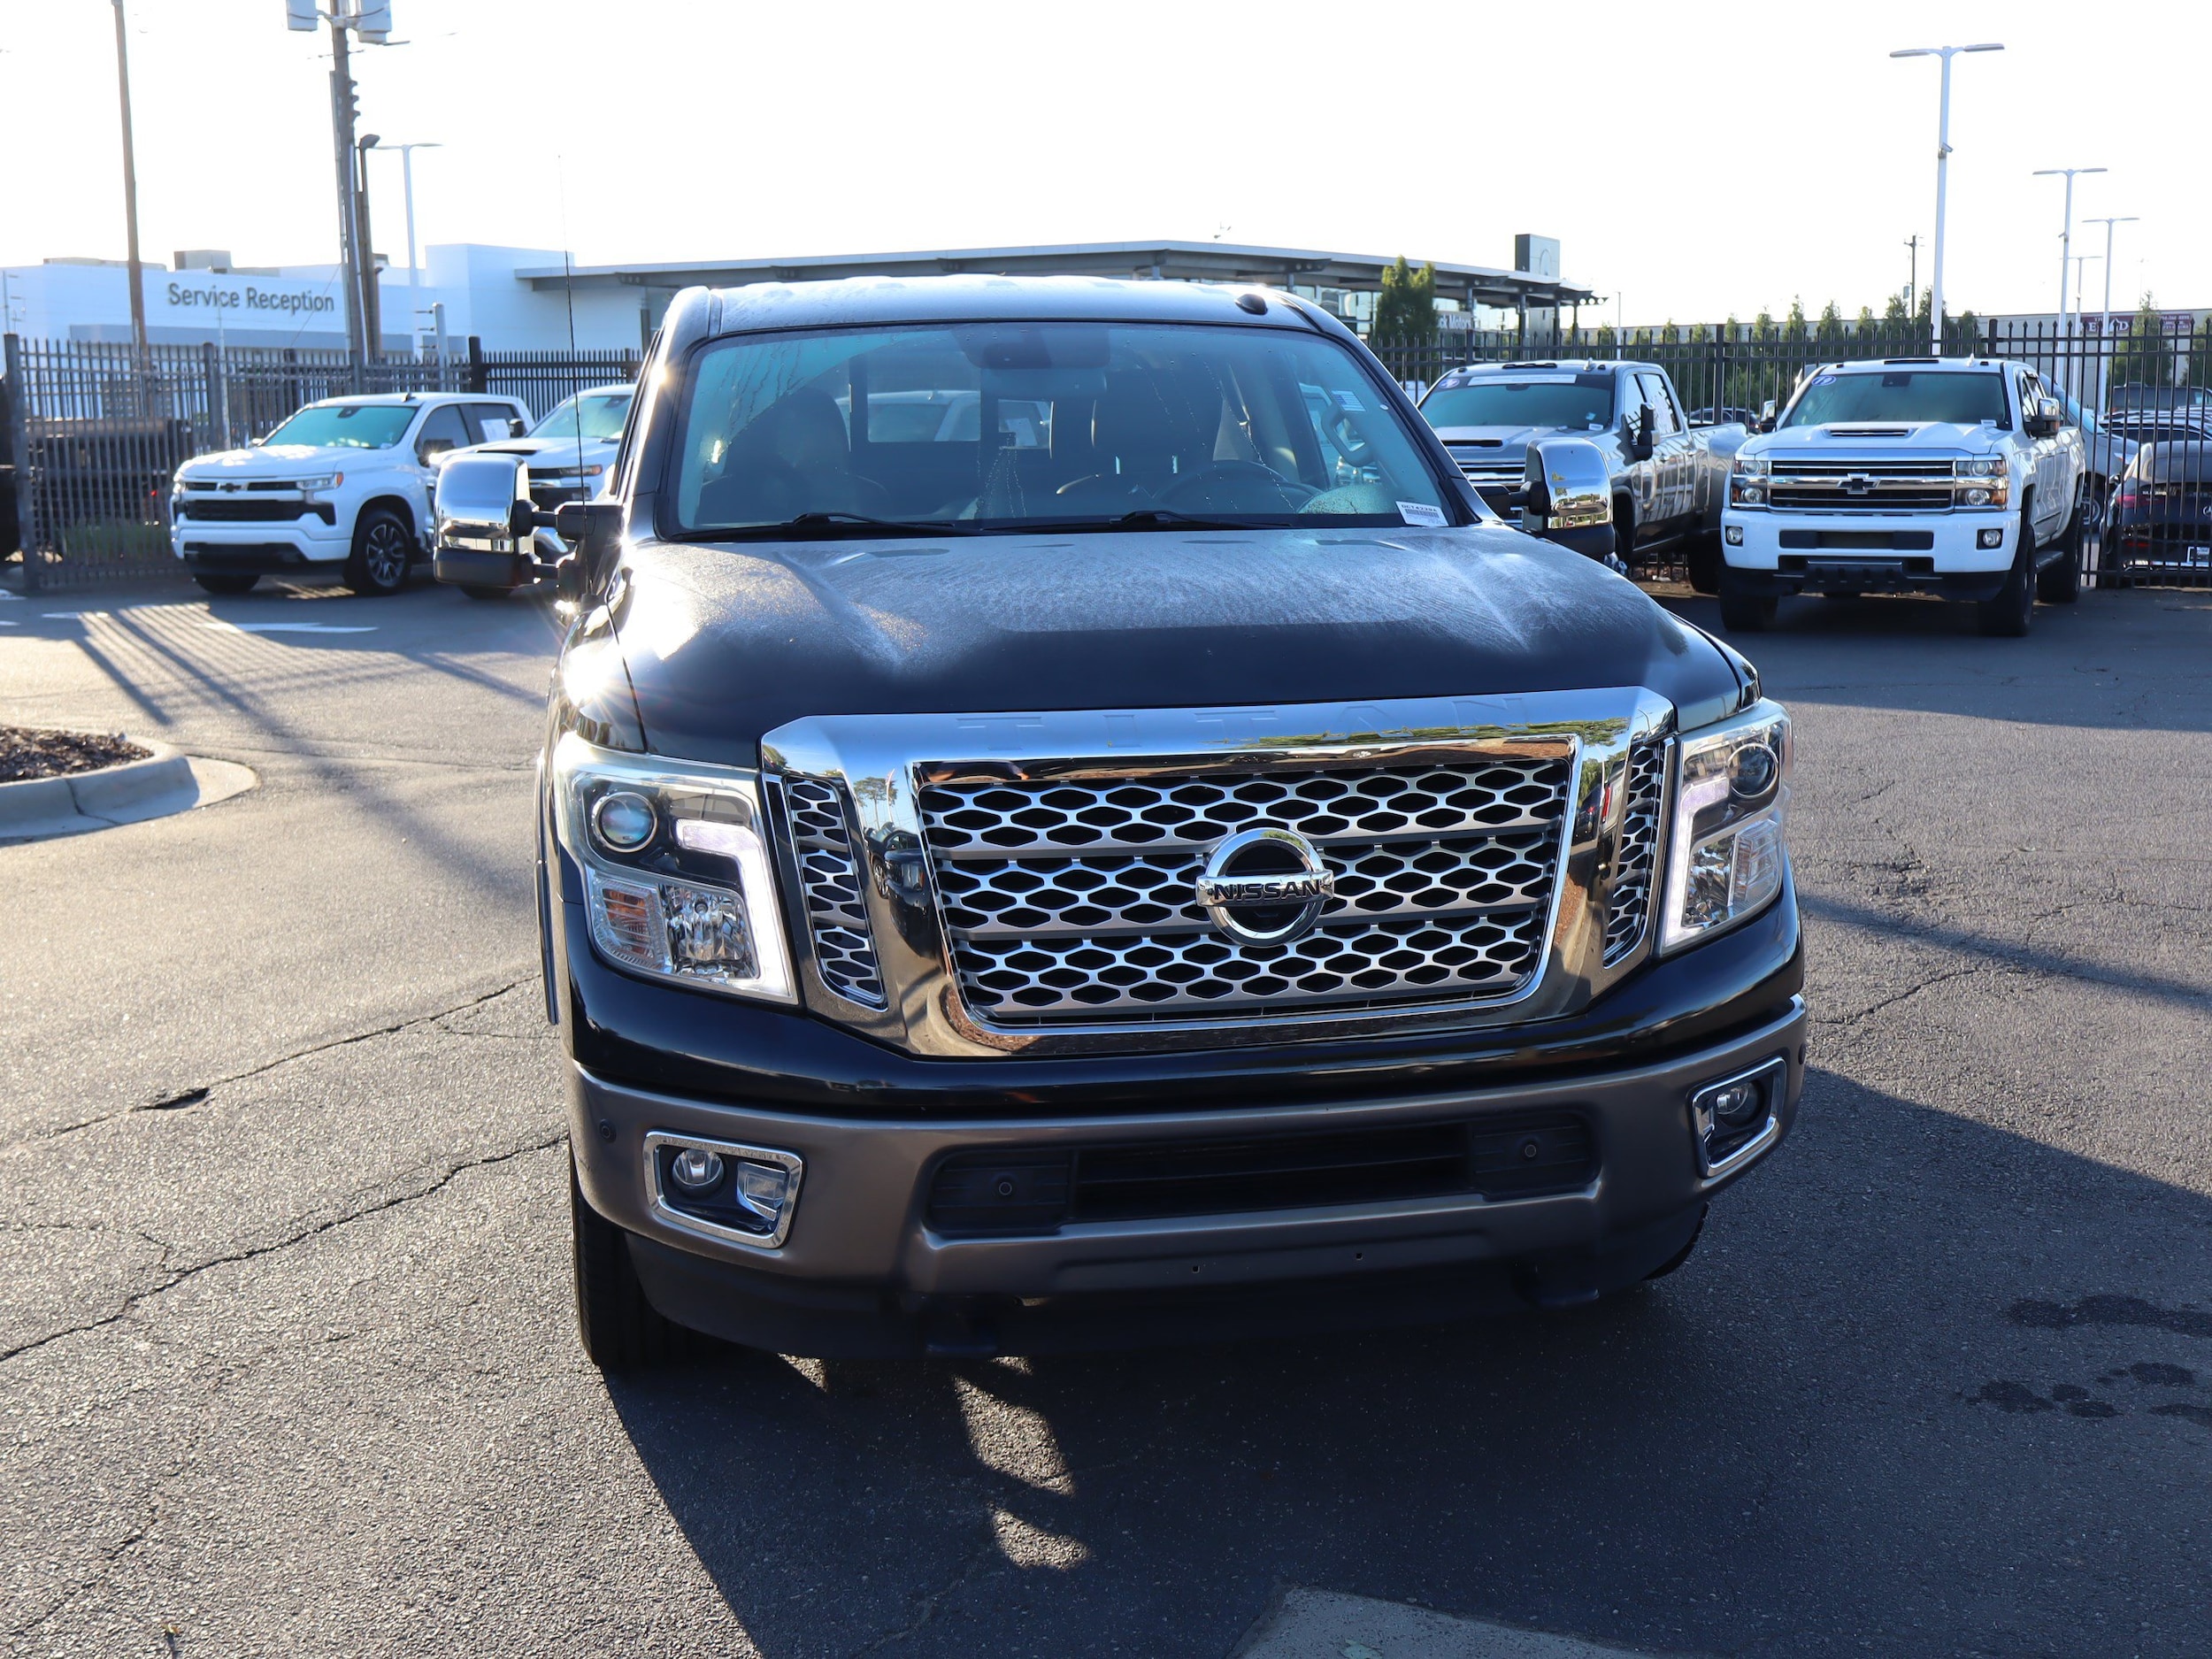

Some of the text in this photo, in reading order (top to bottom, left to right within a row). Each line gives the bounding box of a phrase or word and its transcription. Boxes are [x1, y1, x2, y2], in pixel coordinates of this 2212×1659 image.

[168, 282, 334, 316] Service Reception
[956, 696, 1528, 750] TITAN
[1213, 879, 1321, 901] NISSAN
